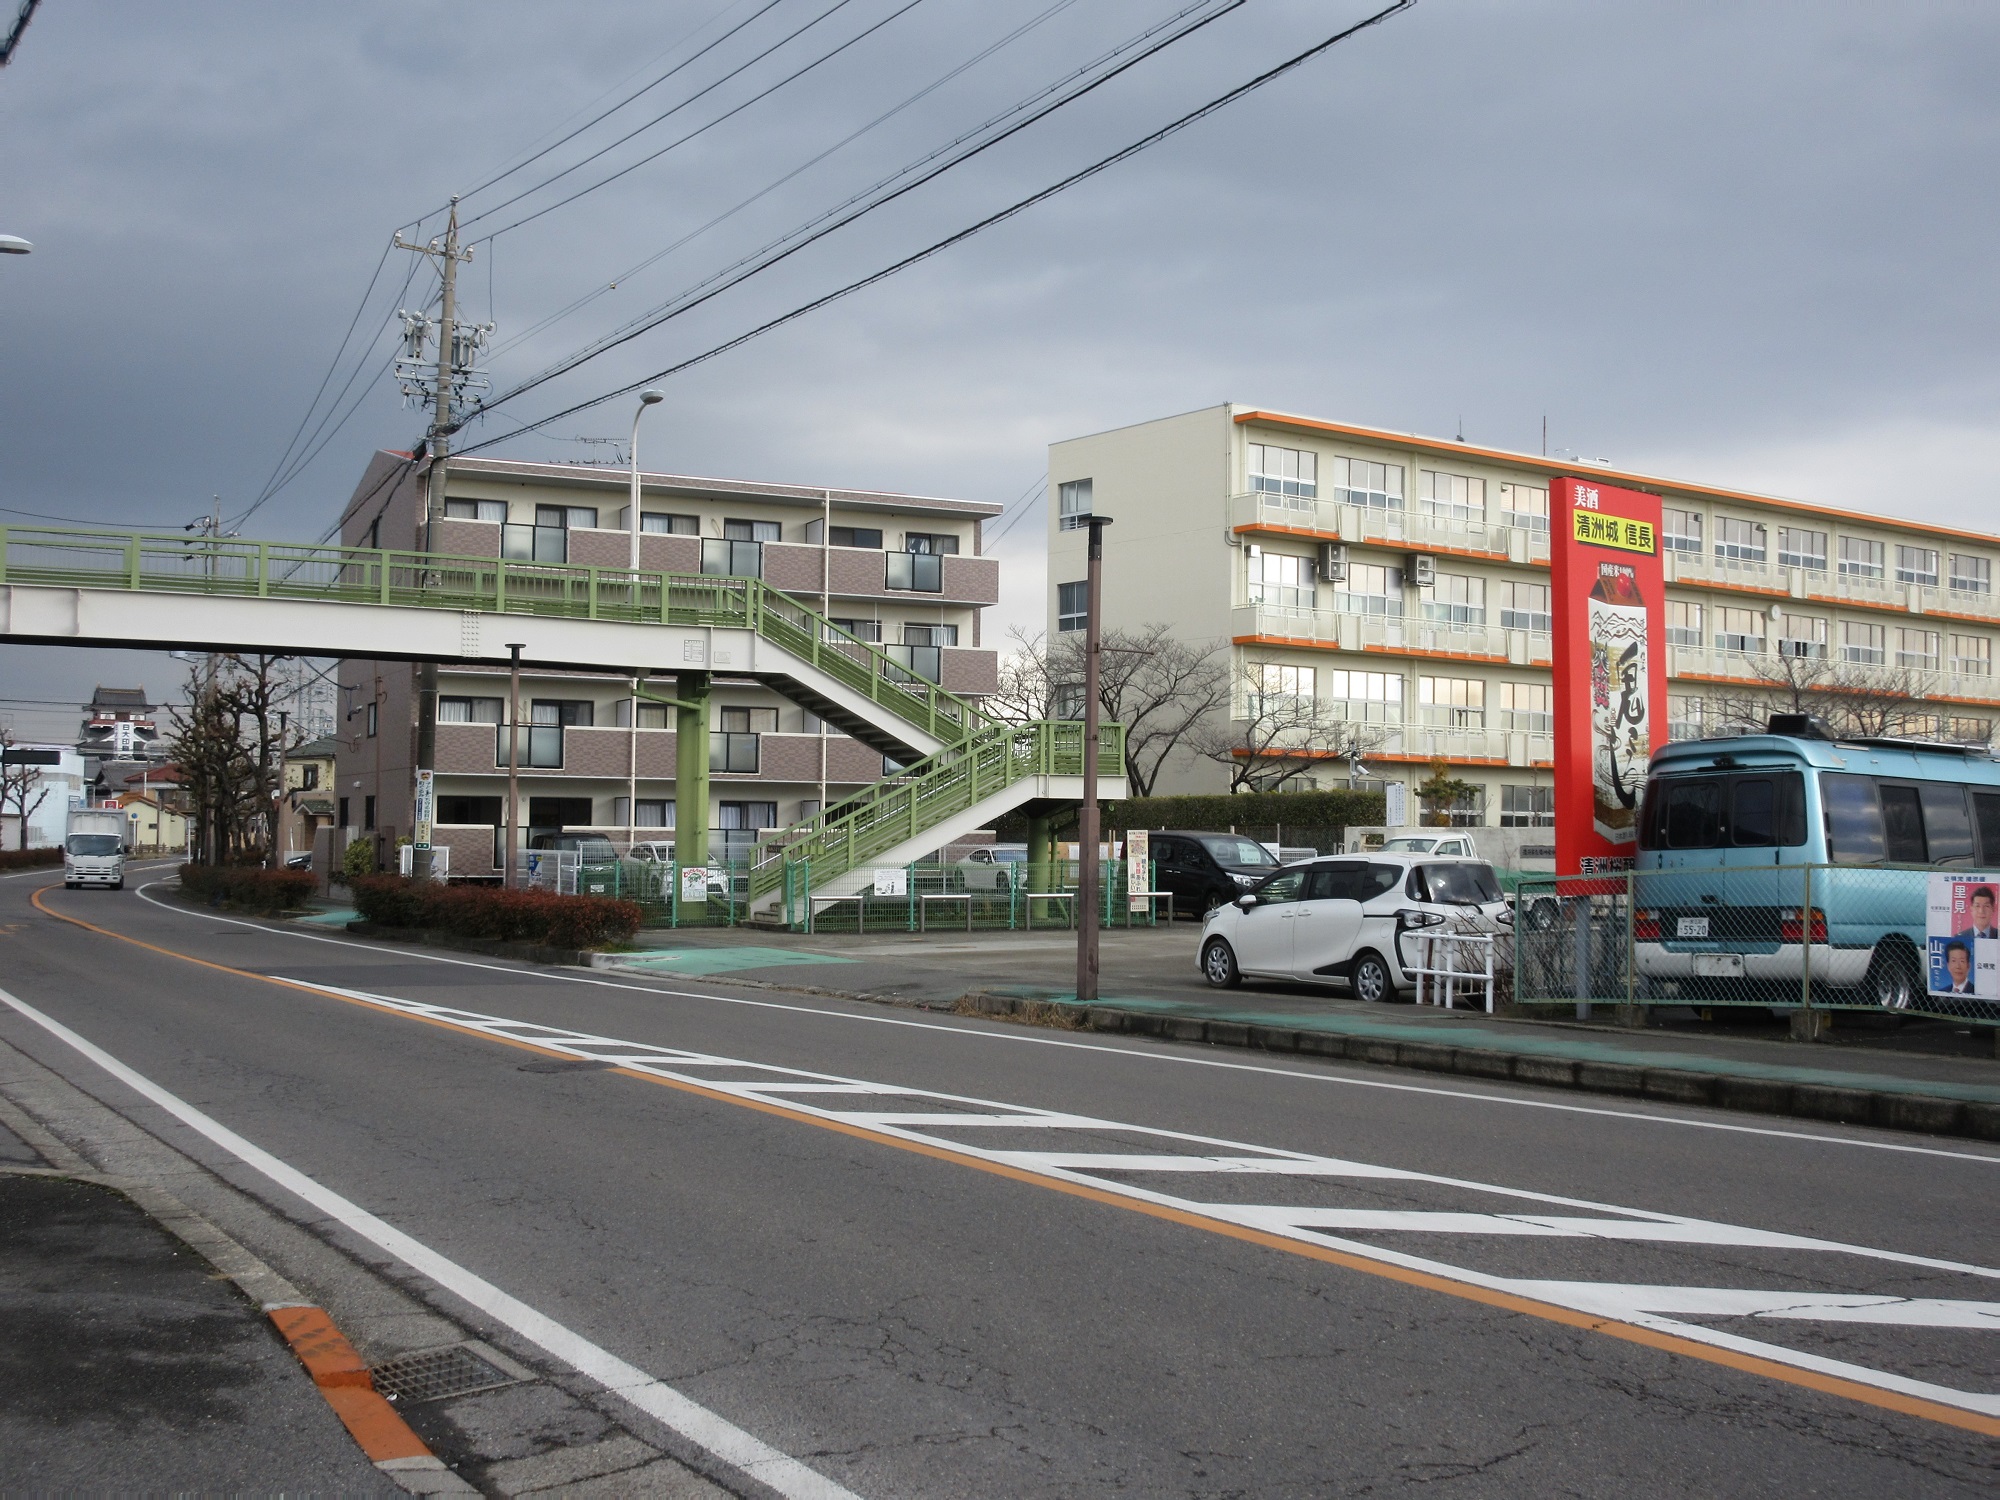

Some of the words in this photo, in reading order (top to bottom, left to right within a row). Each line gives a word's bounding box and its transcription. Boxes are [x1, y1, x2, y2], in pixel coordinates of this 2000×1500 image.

[1574, 484, 1599, 509] 美酒
[1577, 514, 1618, 543] 清洲城
[1625, 523, 1651, 548] 信長
[1684, 925, 1707, 935] 55-20
